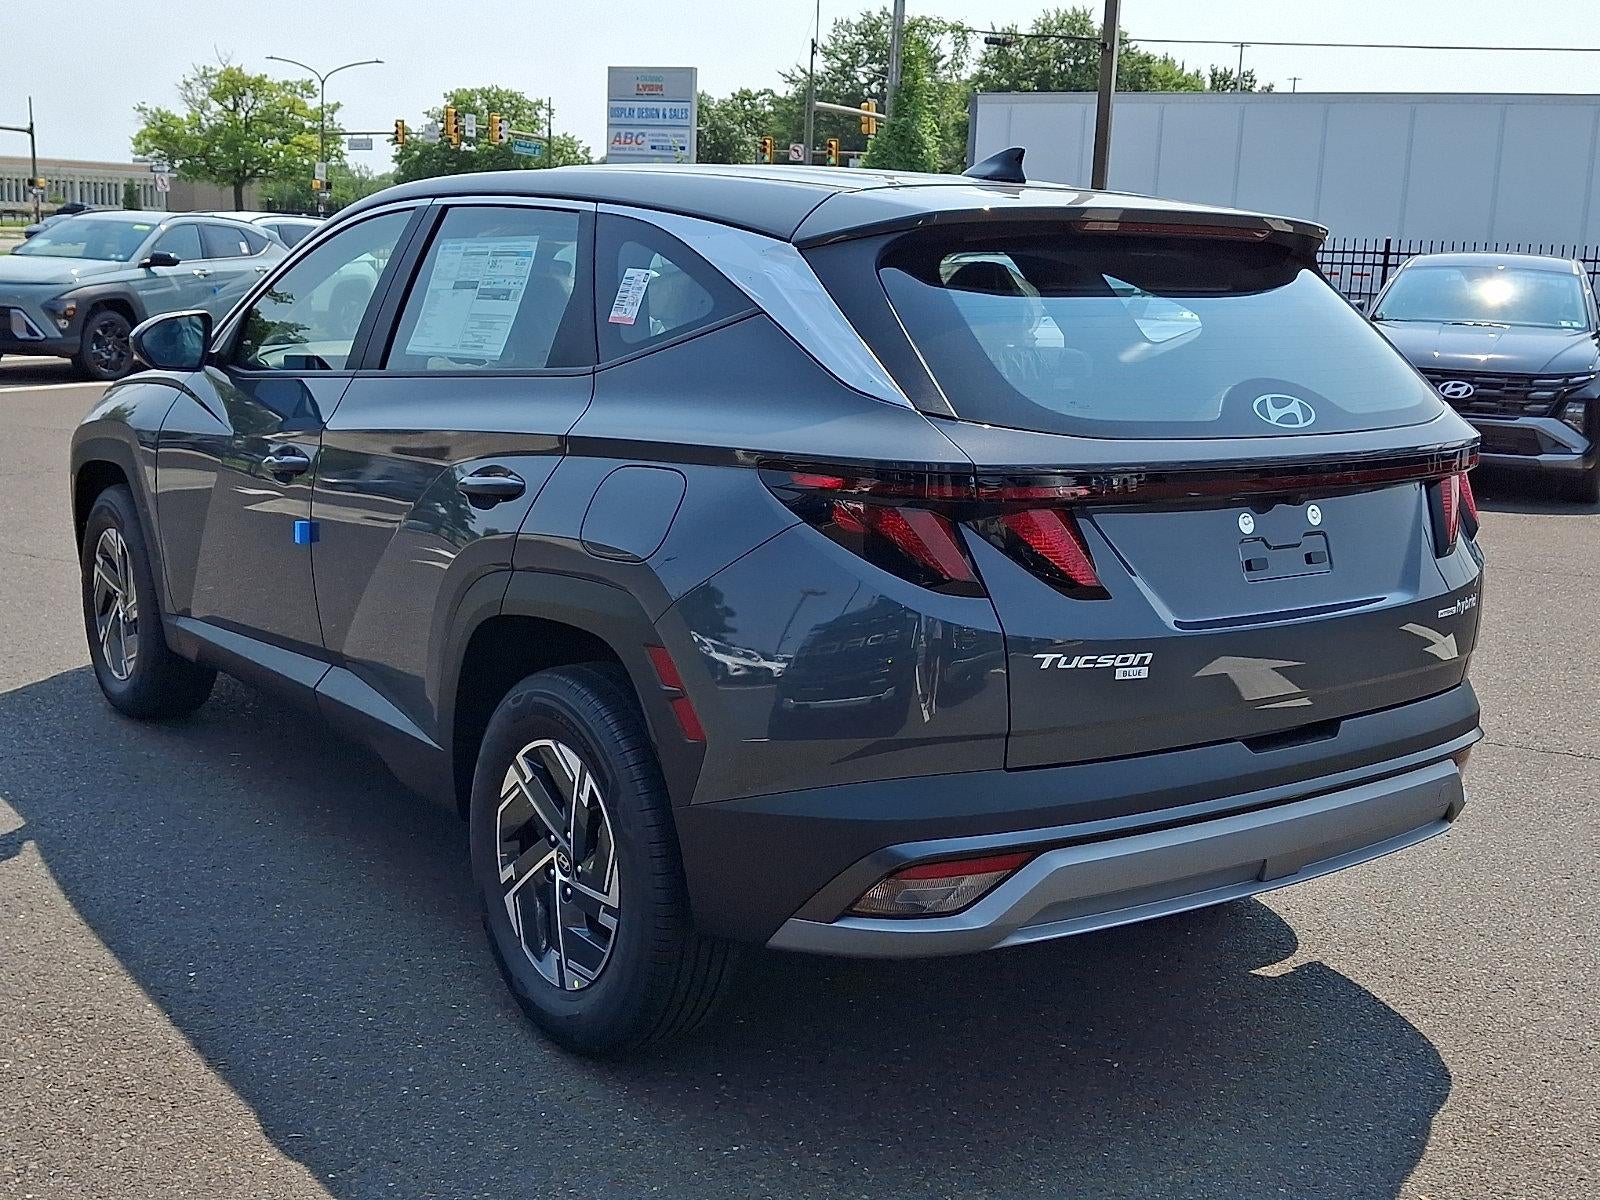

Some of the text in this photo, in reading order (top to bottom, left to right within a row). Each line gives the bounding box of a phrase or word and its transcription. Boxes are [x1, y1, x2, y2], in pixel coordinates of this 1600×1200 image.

[610, 107, 635, 118] DISPLAY
[637, 107, 660, 119] DESIGN
[669, 108, 689, 119] SALES
[612, 131, 647, 146] ABC
[1122, 669, 1142, 678] BLUE
